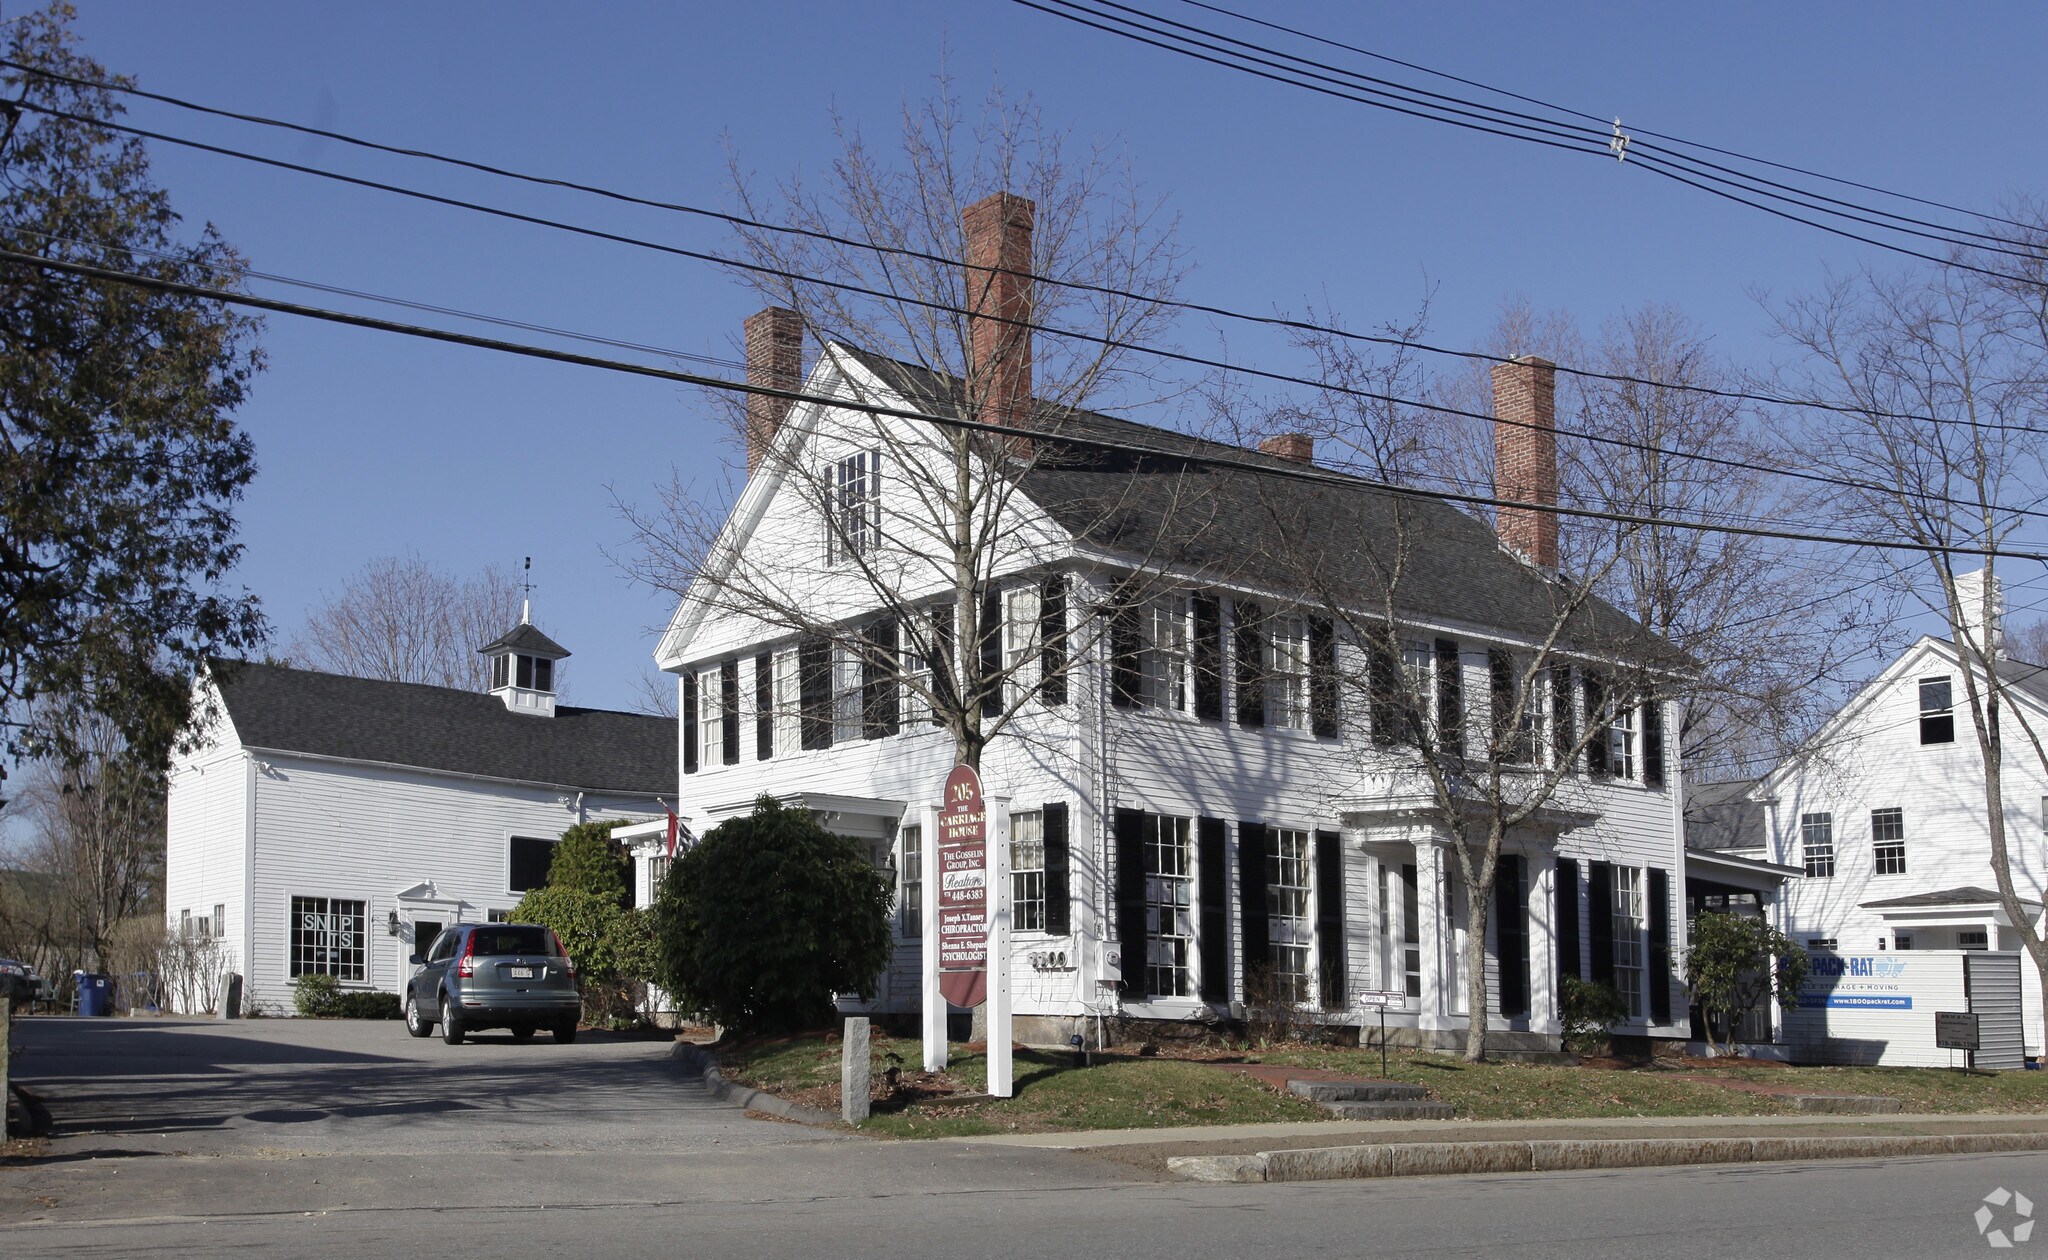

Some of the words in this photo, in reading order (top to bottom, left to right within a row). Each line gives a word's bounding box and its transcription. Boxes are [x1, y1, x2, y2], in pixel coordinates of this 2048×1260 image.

[951, 782, 973, 802] 205
[940, 812, 986, 827] CARRIAGE
[949, 825, 978, 838] HOUSE
[943, 852, 955, 860] THE
[956, 850, 984, 860] GOSSELIN
[968, 859, 981, 868] INC.
[945, 873, 984, 888] Realtors
[952, 889, 984, 901] 448-6383
[304, 914, 351, 931] SNIP
[944, 913, 960, 924] Joseph
[941, 923, 987, 934] CHIROPRACTOR
[320, 931, 351, 947] ITS
[942, 951, 987, 961] PSYCHOLOGIST
[1833, 997, 1906, 1006] www.1800packrat.com
